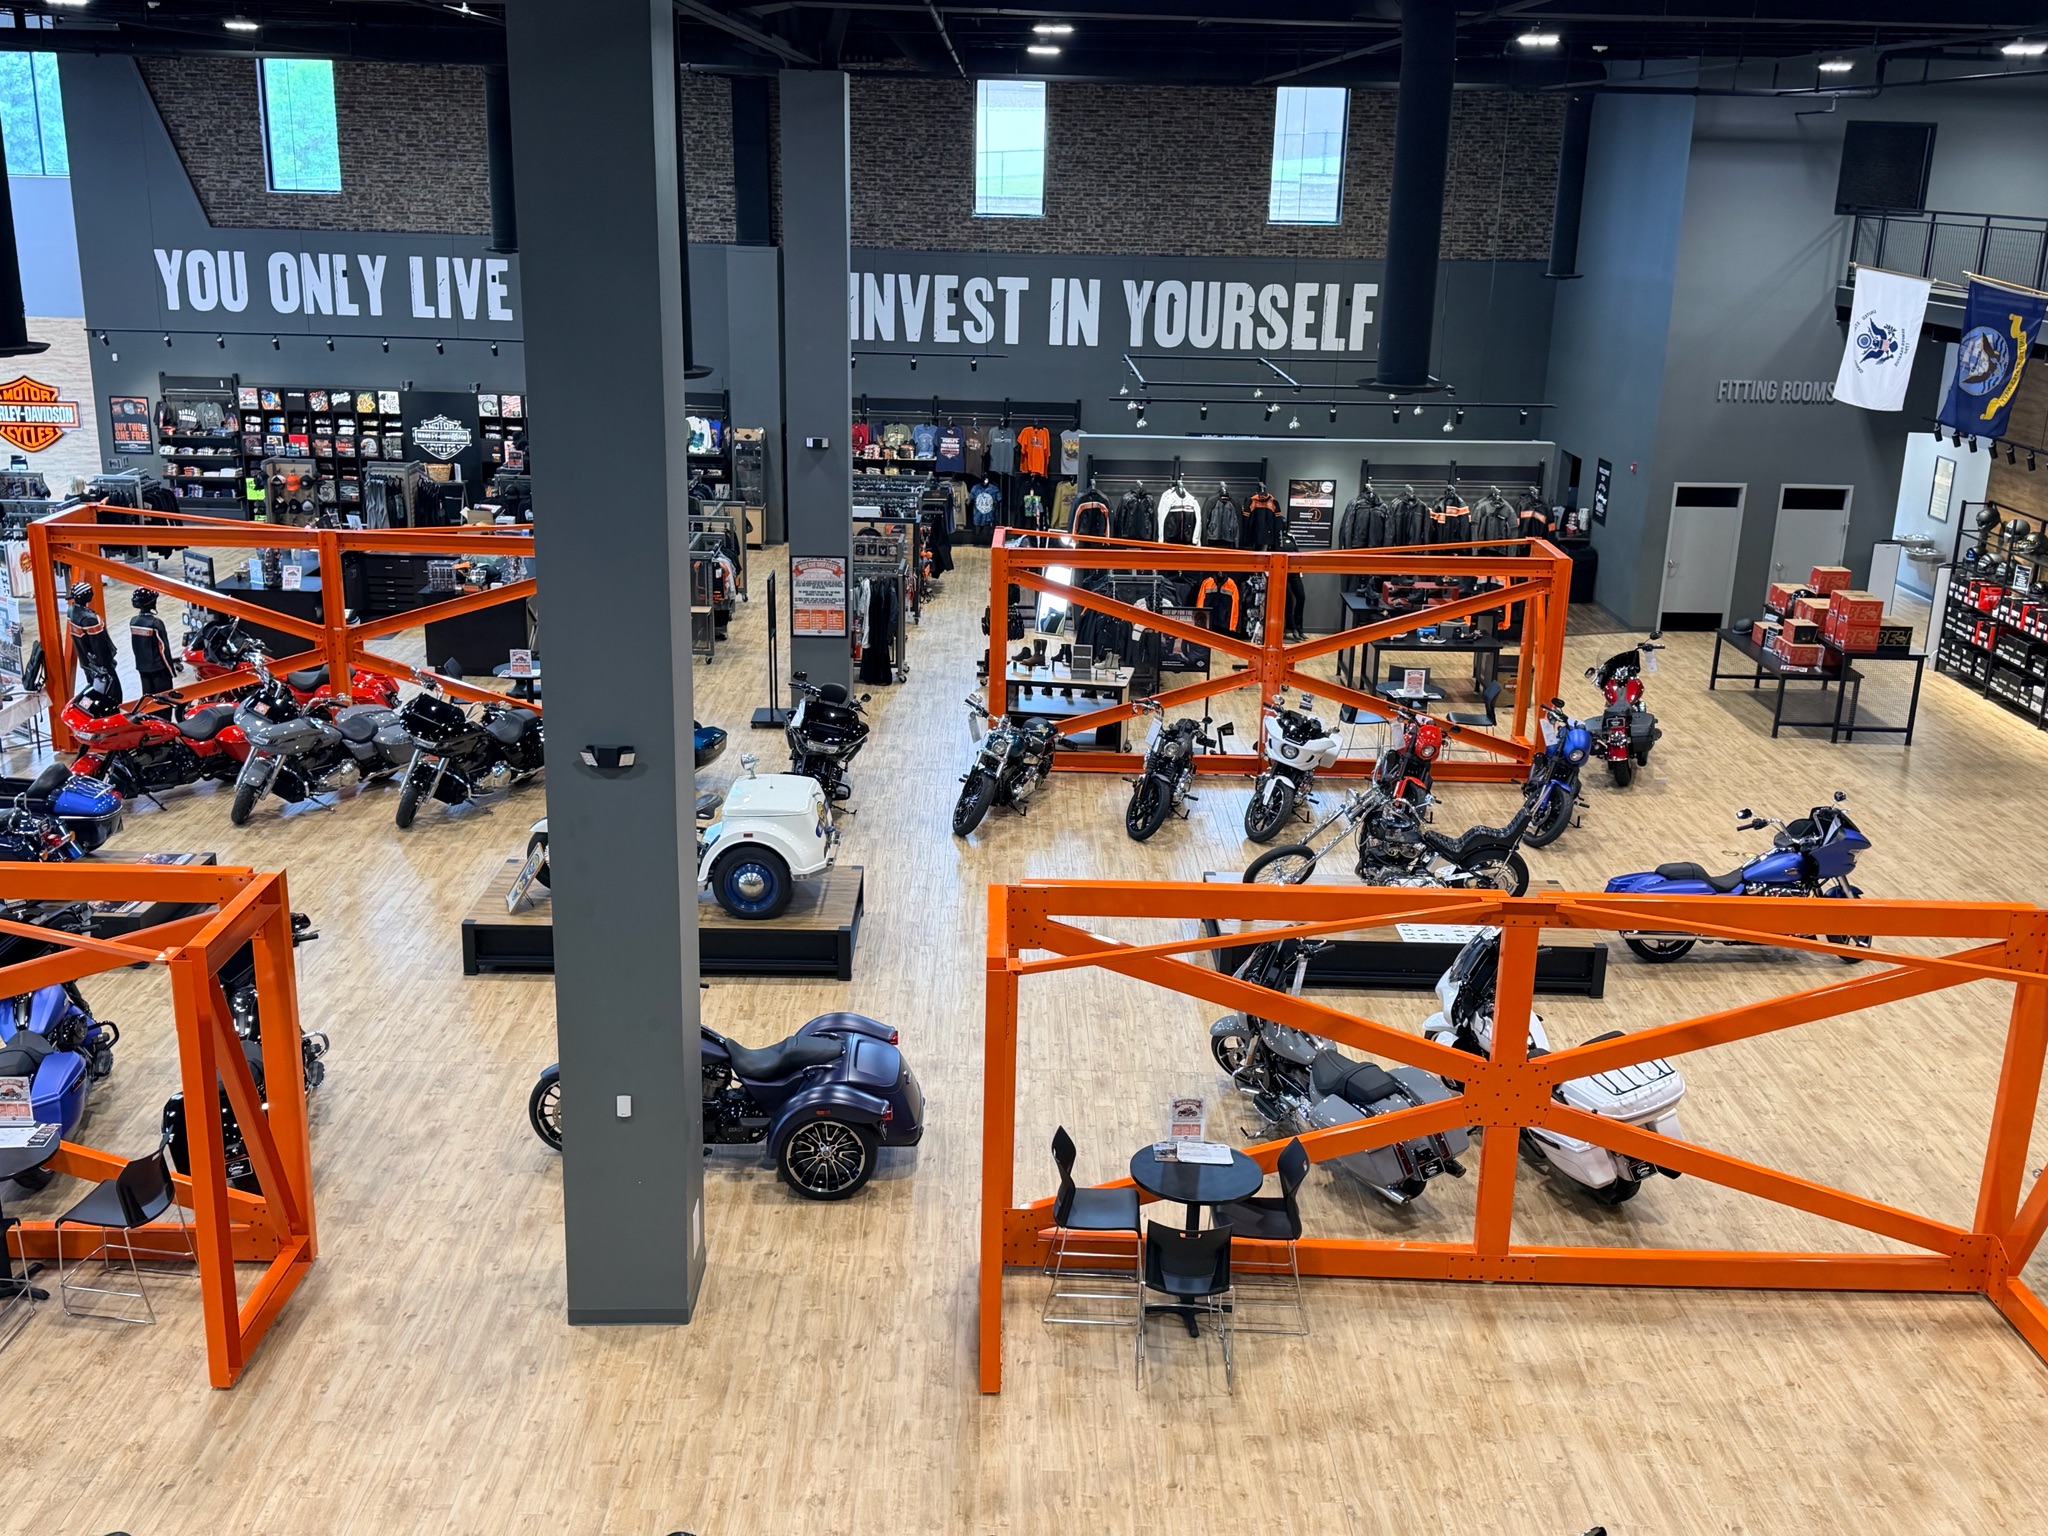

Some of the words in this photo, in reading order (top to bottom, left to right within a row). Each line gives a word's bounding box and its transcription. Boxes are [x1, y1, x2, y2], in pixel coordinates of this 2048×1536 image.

[154, 249, 249, 313] YOU
[268, 252, 387, 316] ONLY
[409, 256, 513, 321] LIVE
[850, 272, 1029, 345] INVEST
[1048, 278, 1101, 346] IN
[3, 383, 51, 402] MOTOR
[1718, 379, 1778, 401] FITTING
[1780, 381, 1837, 402] ROOMS
[6, 426, 55, 447] CYCLES
[114, 422, 127, 431] BUY
[127, 423, 142, 431] TWO
[115, 431, 130, 440] ONE
[131, 431, 149, 441] FREE
